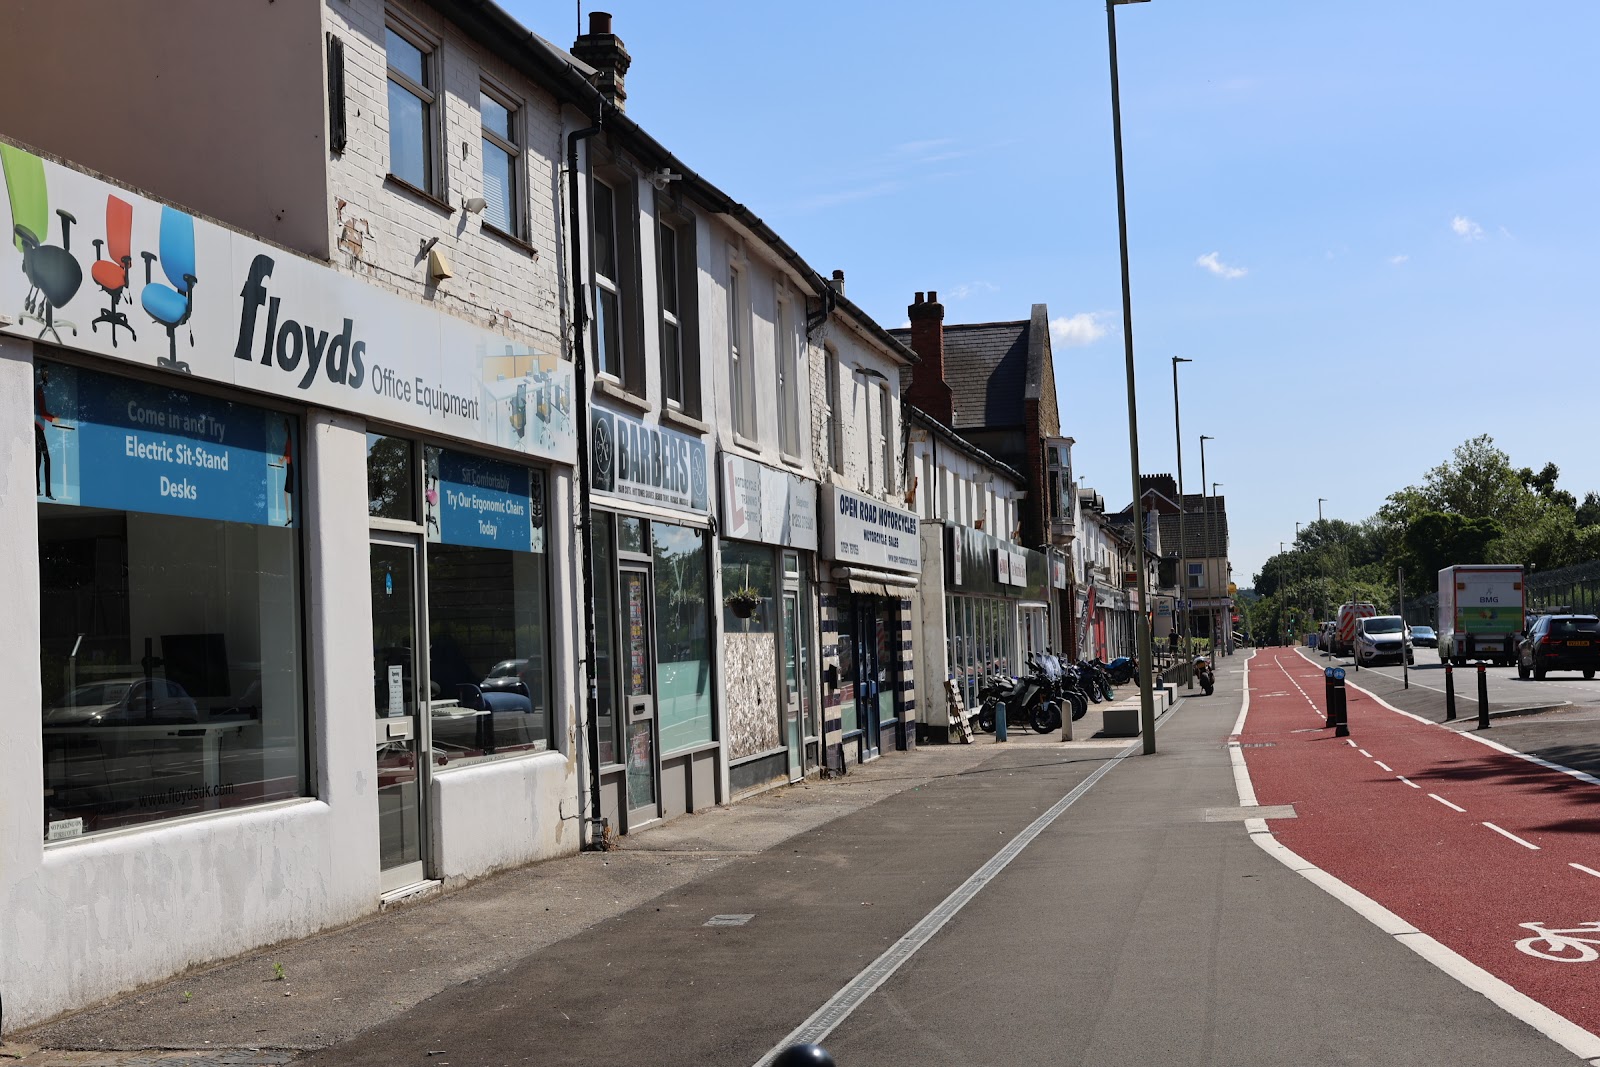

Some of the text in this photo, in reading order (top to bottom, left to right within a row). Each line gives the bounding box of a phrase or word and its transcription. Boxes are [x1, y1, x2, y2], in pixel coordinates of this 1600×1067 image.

[234, 254, 479, 420] floyds Office Equipment
[127, 401, 226, 443] Come in and Try
[125, 435, 229, 471] Electric Sit-Stand
[618, 419, 689, 495] BARBERS
[160, 476, 197, 500] Desks
[471, 470, 510, 494] Comfortably
[446, 490, 524, 516] Try Our Ergonomic Chairs
[840, 494, 917, 536] OPEN ROAD MOTORCYCLES
[478, 520, 498, 540] Today
[864, 529, 899, 548] MOTORCYCLE SALES
[138, 782, 235, 808] www.floydsuk.com
